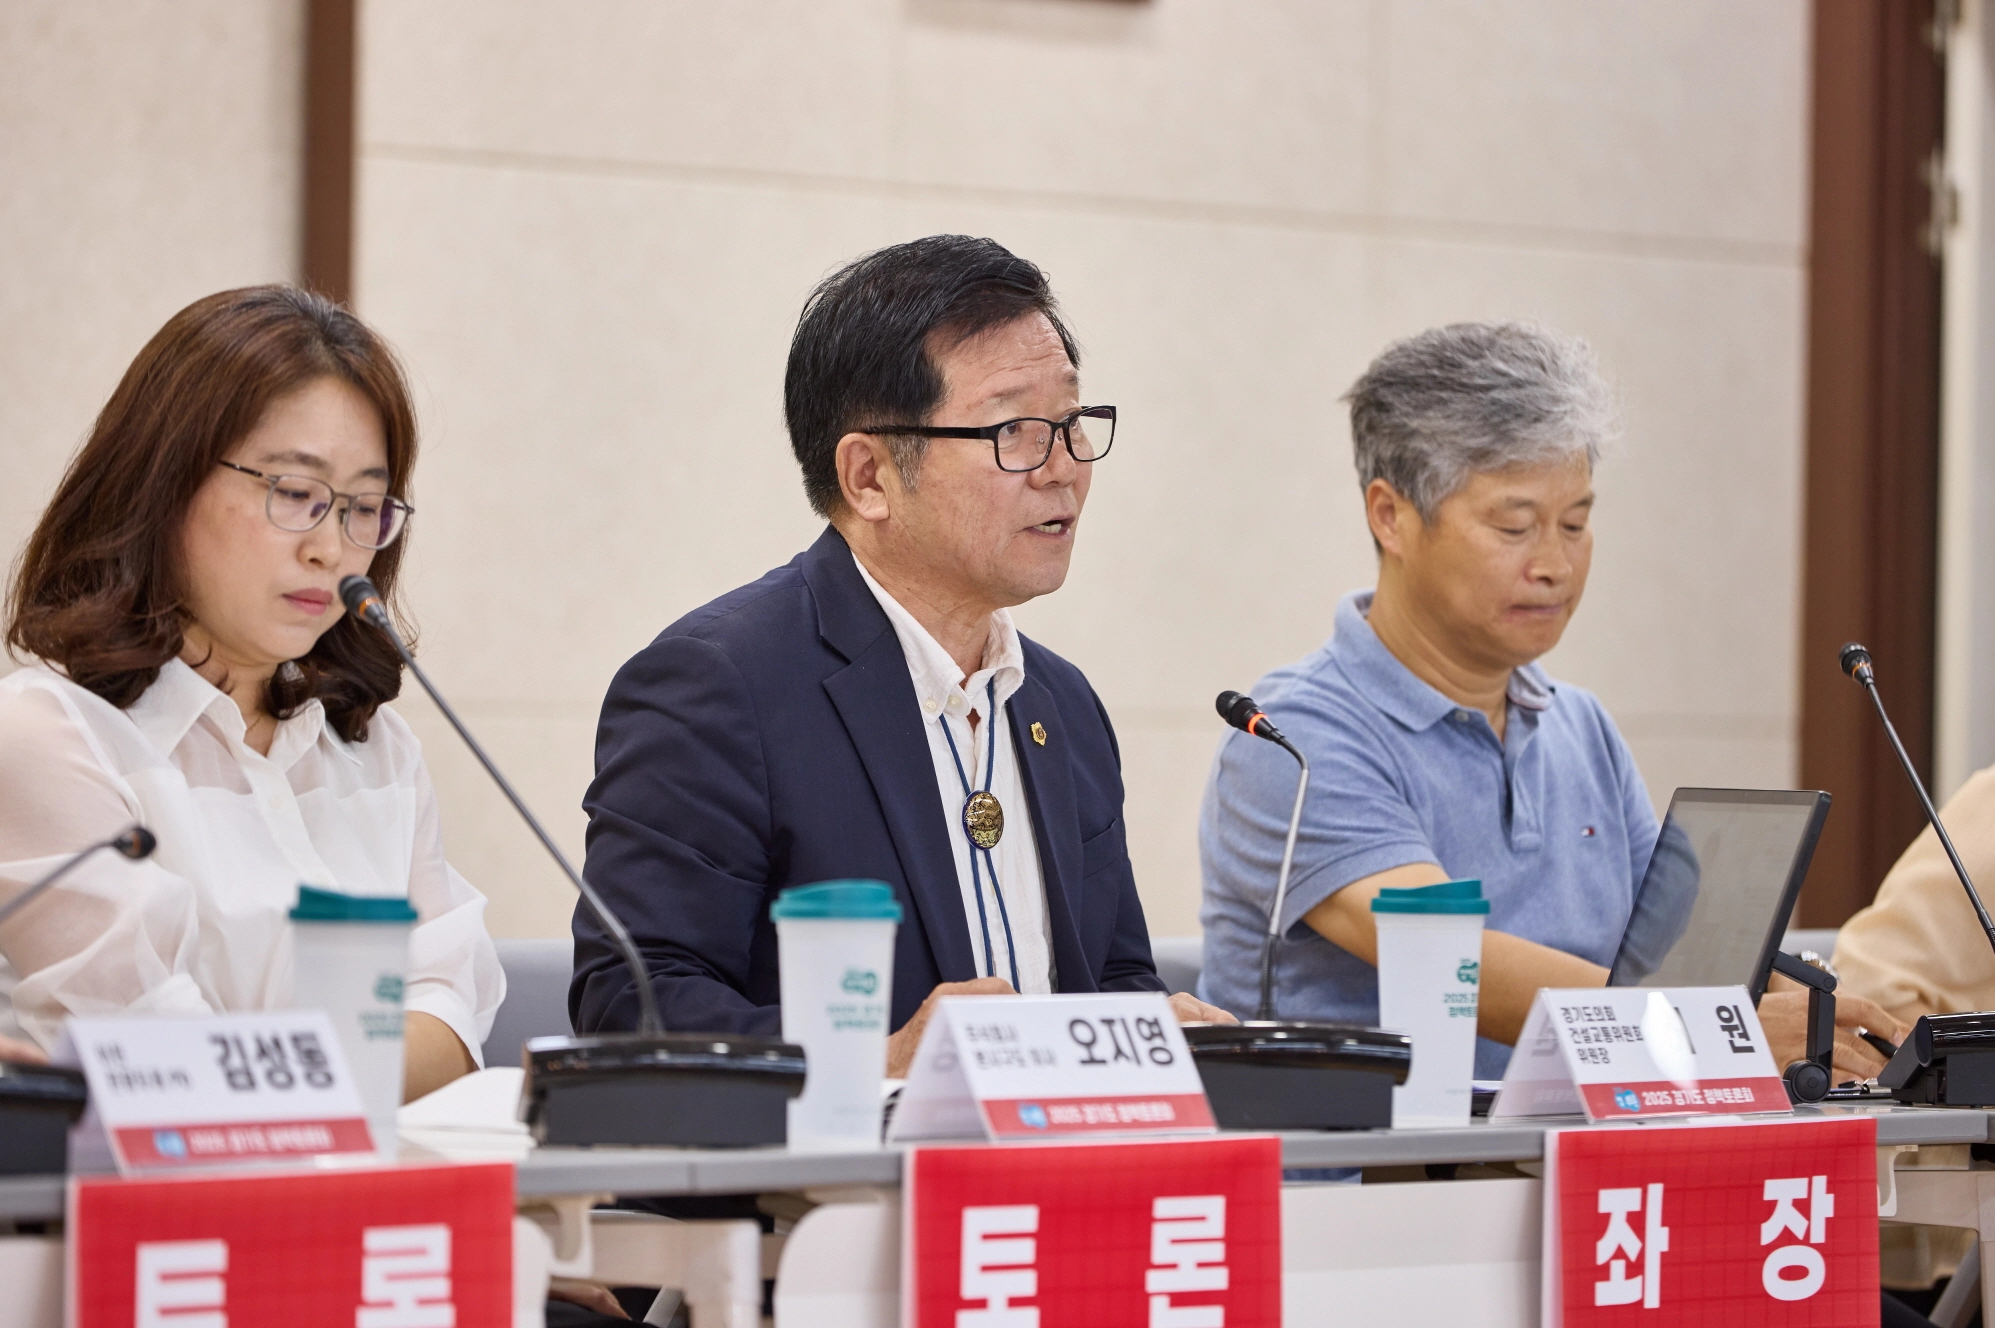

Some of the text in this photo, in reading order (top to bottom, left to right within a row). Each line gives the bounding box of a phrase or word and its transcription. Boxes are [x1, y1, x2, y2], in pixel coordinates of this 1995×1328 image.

[1560, 1006, 1616, 1023] 경기도의회
[1568, 1026, 1644, 1044] 건설교통위원회
[1716, 1005, 1755, 1053] 원
[1068, 1017, 1174, 1066] 오지영
[1577, 1048, 1610, 1064] 위원장
[1641, 1091, 1672, 1106] 2025
[1671, 1089, 1704, 1105] 경기도
[1703, 1087, 1755, 1104] 정책토론회
